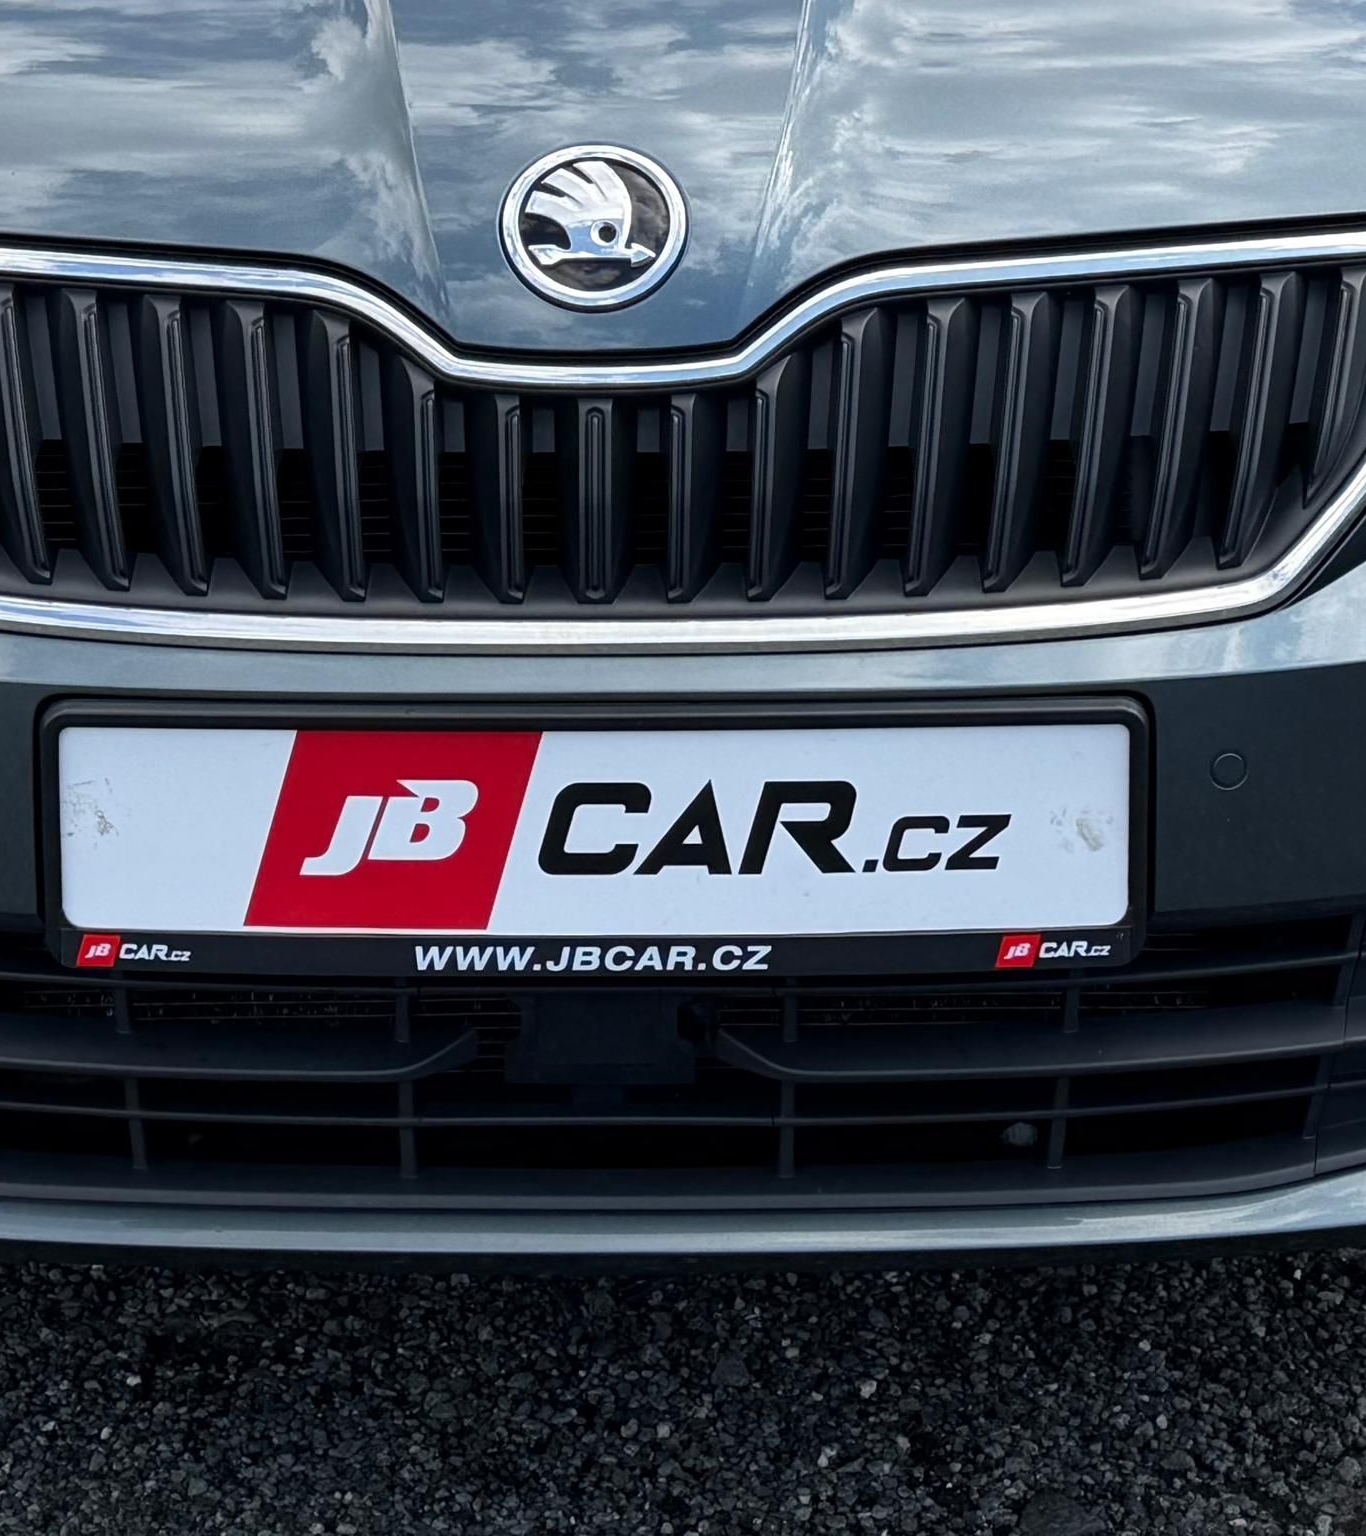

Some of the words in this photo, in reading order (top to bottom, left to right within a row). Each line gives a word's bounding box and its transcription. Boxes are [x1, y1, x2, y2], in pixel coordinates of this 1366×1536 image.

[299, 779, 479, 875] JB
[84, 943, 111, 959] JB
[414, 945, 772, 972] WWW.JBCAR.CZ
[1003, 943, 1031, 960] JB
